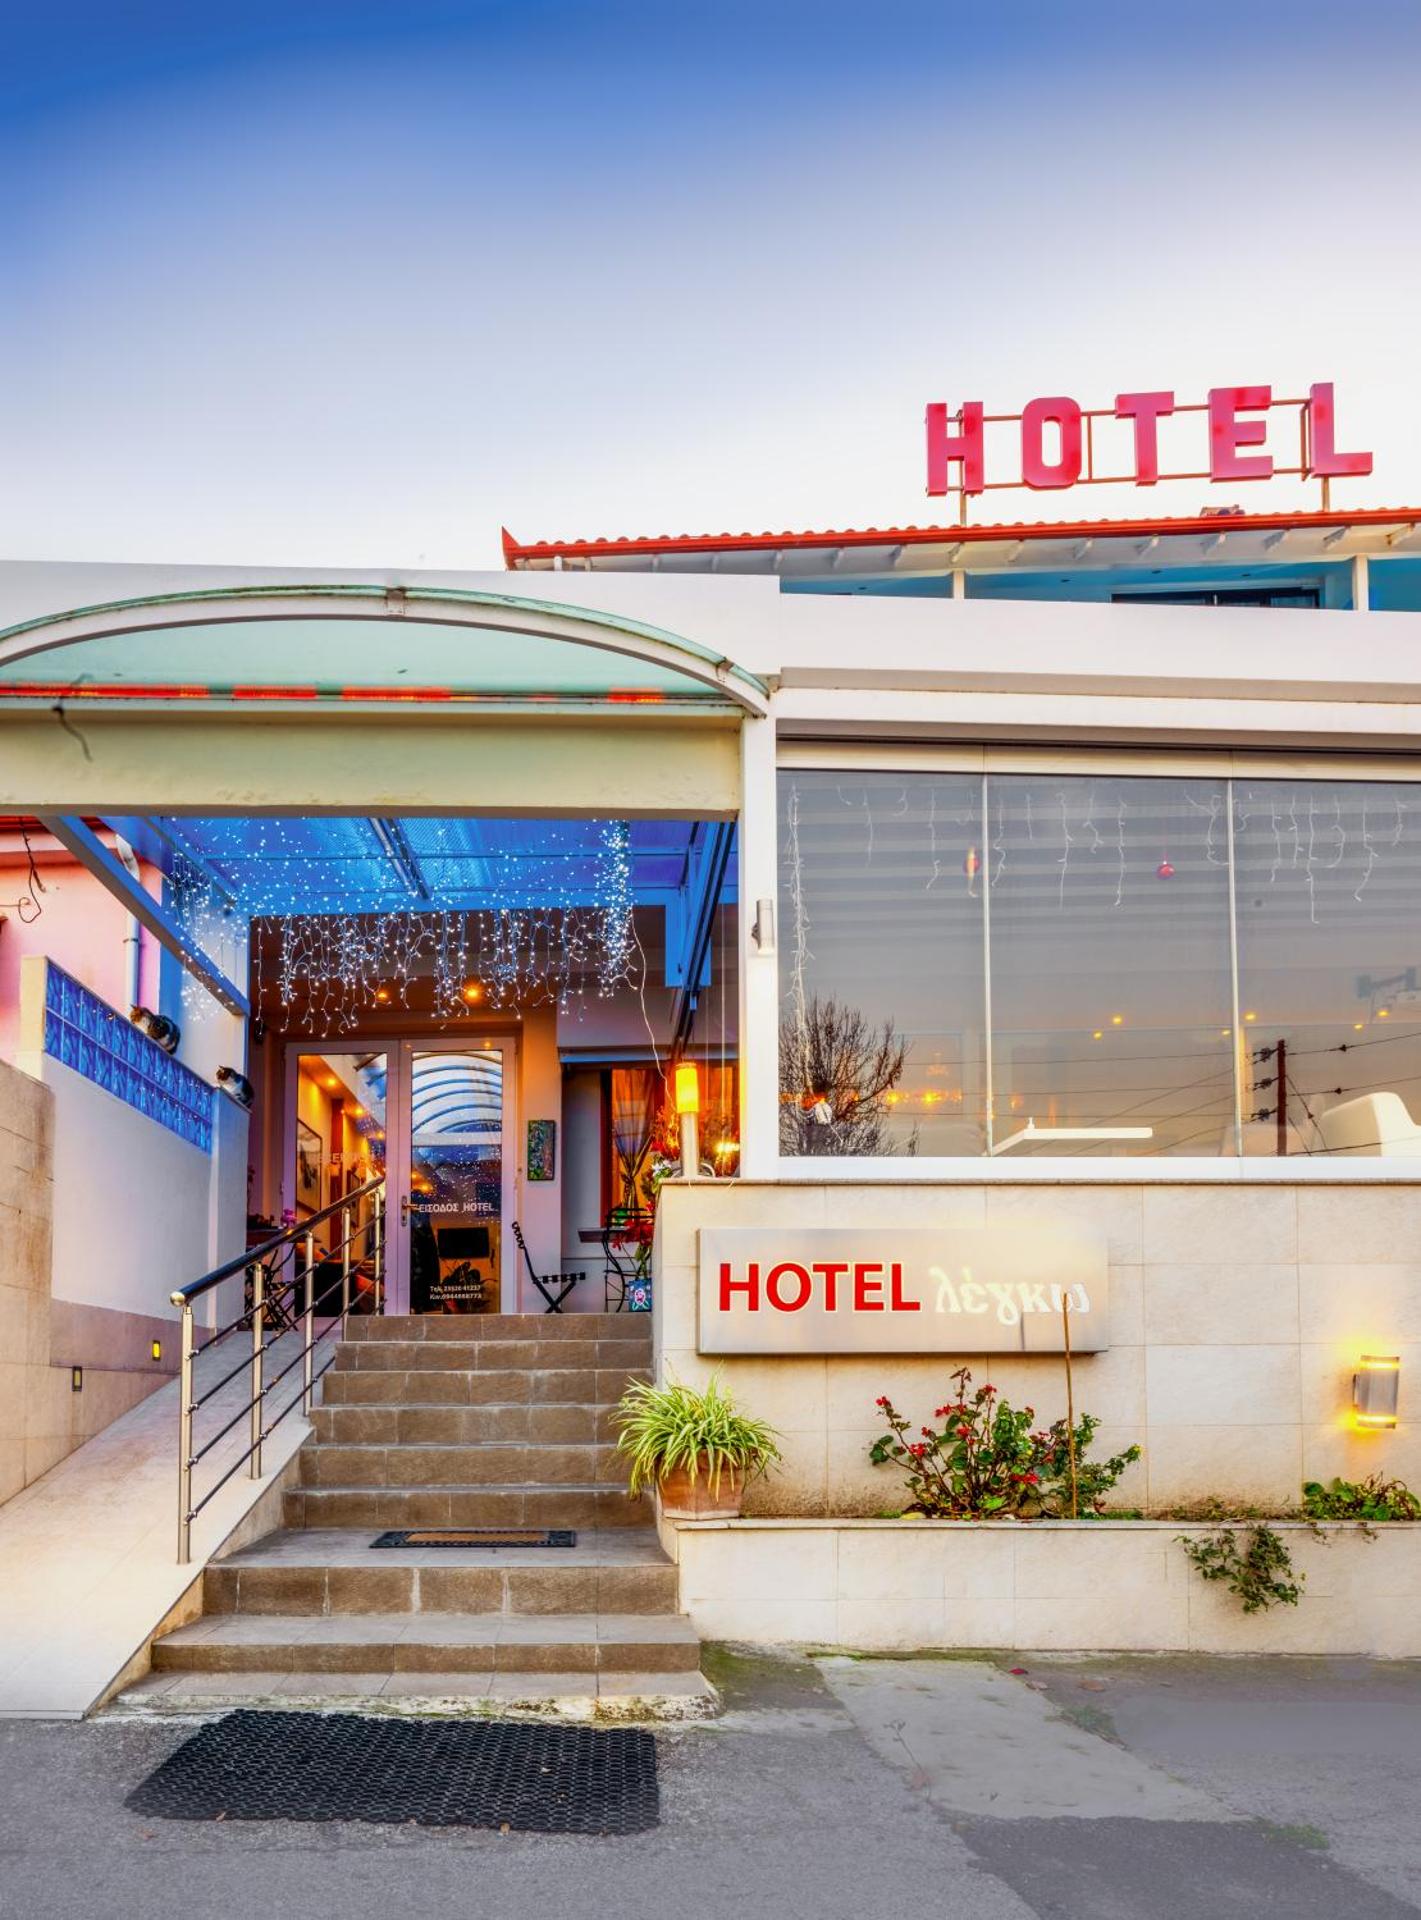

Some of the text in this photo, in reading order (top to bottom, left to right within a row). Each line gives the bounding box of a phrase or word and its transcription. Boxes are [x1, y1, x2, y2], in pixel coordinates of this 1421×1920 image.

[925, 382, 1373, 496] HOTEL
[462, 1202, 494, 1212] HOTEL
[718, 1261, 922, 1313] HOTEL
